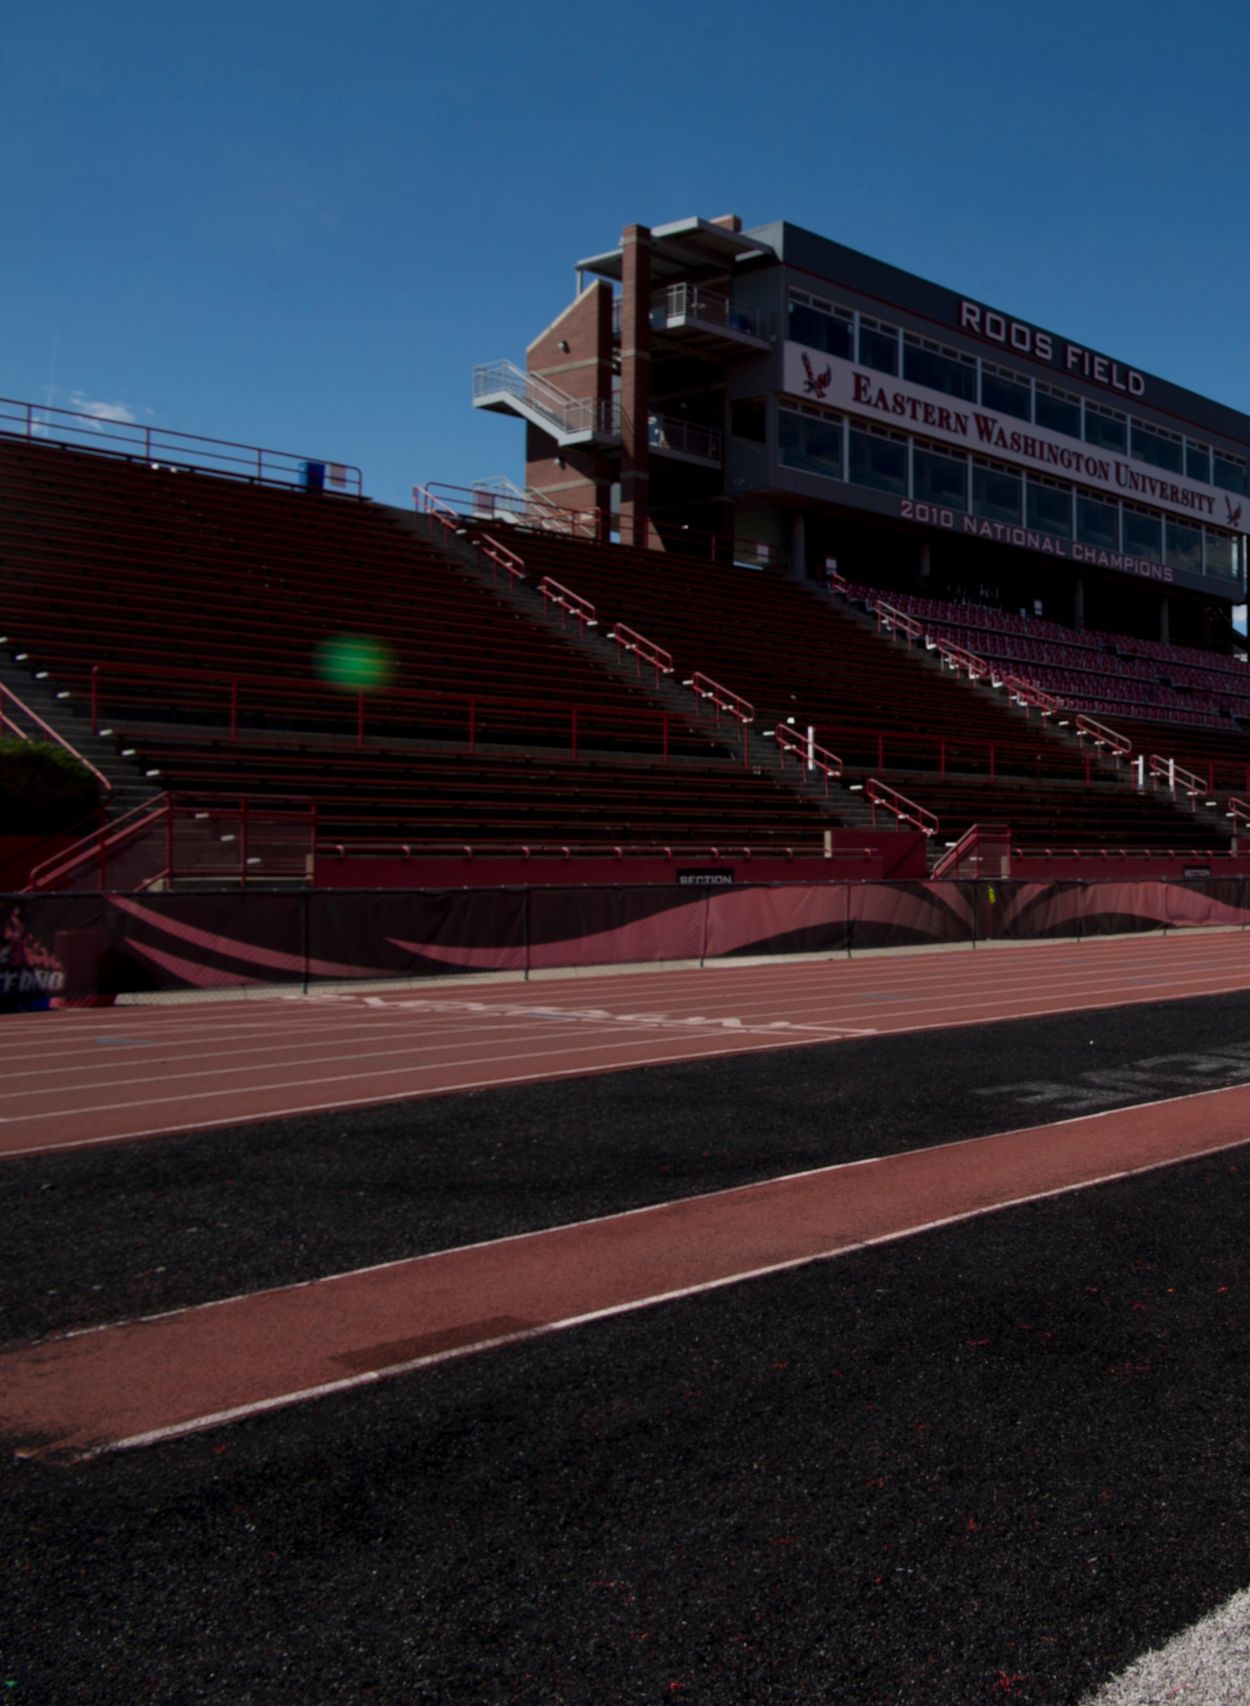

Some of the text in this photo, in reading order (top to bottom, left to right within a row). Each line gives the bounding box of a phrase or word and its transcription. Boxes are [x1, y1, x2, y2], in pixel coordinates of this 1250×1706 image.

[961, 301, 1145, 396] ROOS FIELD
[852, 371, 1216, 514] EASTERN WASHINGTON UNIVERSITY
[900, 500, 1174, 582] 2010 NATIONAL CHAMPIONS
[679, 874, 733, 885] SECTION
